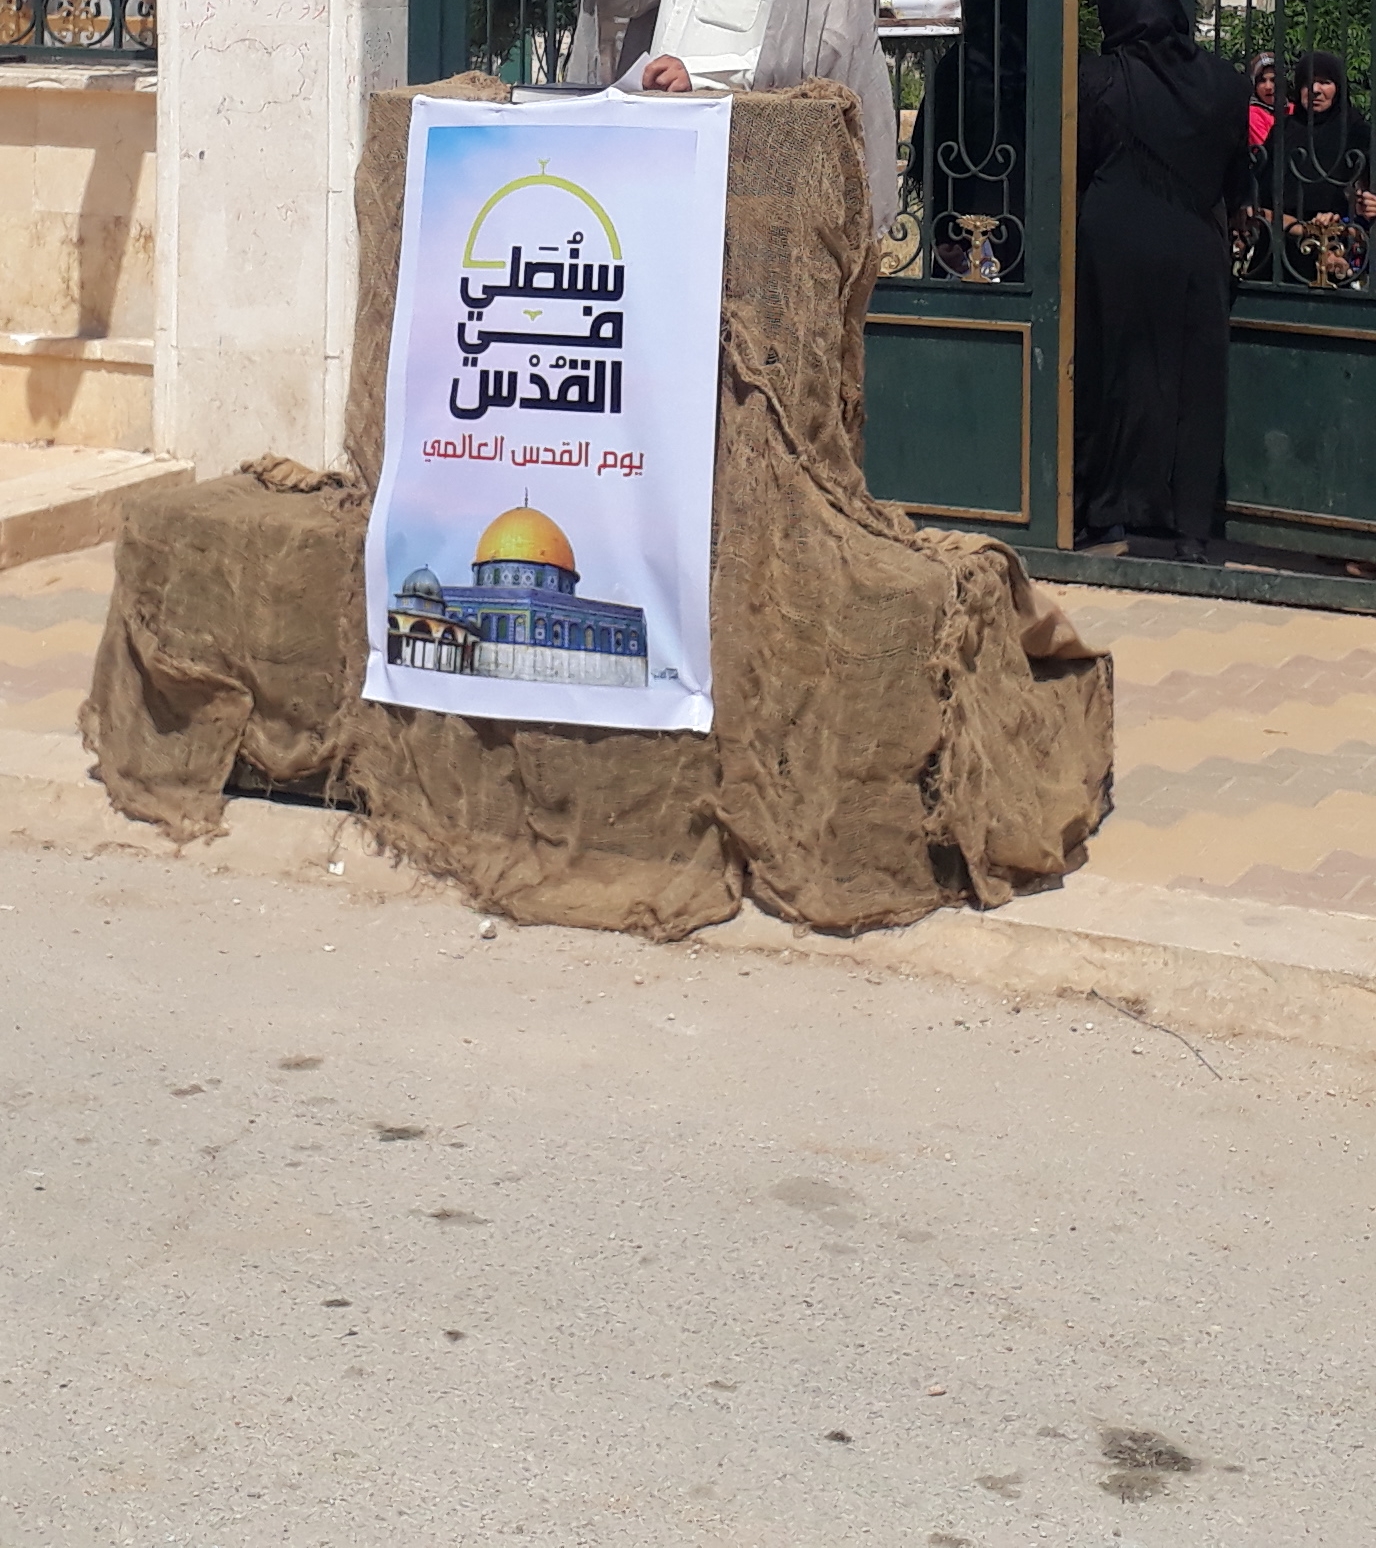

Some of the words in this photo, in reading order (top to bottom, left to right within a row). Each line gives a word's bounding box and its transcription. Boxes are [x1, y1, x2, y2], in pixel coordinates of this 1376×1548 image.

[458, 305, 623, 368] في
[423, 433, 505, 463] العالمي
[511, 441, 590, 467] القدس
[597, 450, 645, 477] يوم
